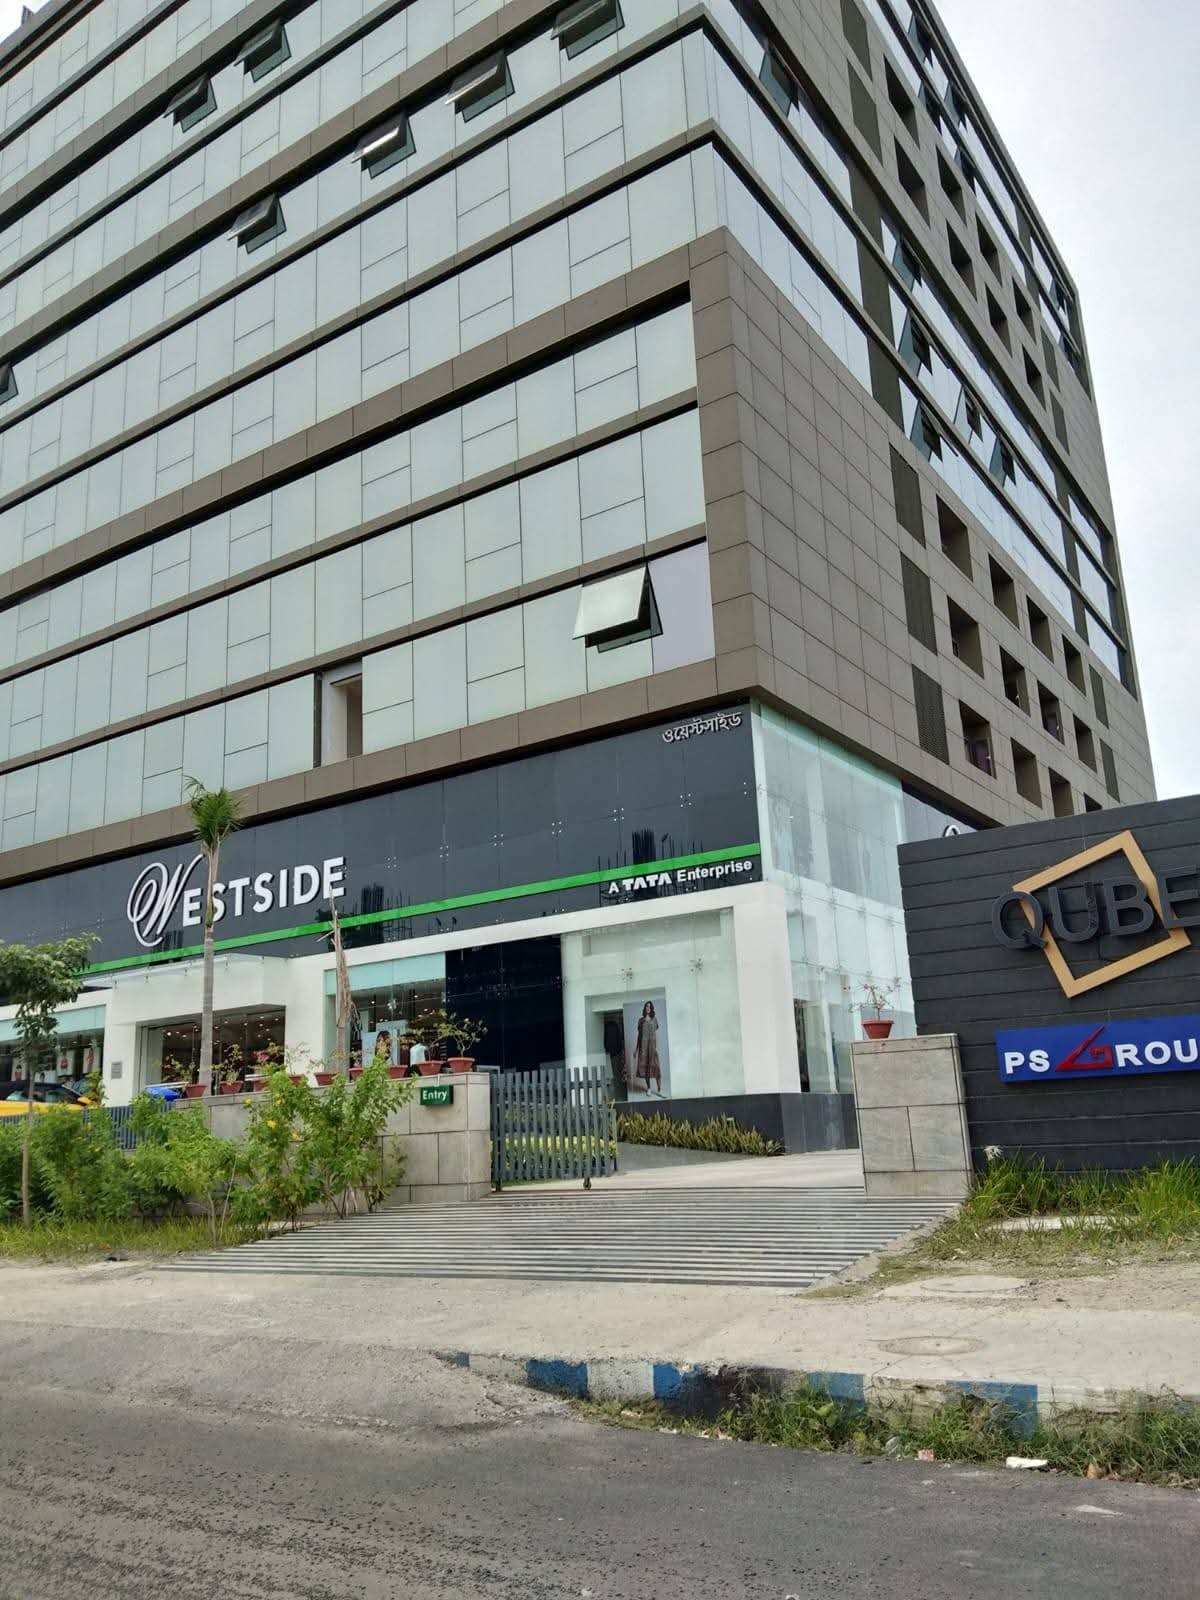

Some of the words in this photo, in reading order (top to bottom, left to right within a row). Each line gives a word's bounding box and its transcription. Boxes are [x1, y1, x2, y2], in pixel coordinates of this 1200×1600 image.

[608, 882, 619, 894] A
[622, 872, 673, 891] TATA
[677, 860, 753, 882] Enterprise
[127, 853, 345, 947] WESTSIDE
[992, 864, 1200, 949] QUBE
[1004, 1050, 1050, 1074] PS
[422, 1090, 448, 1101] Entry
